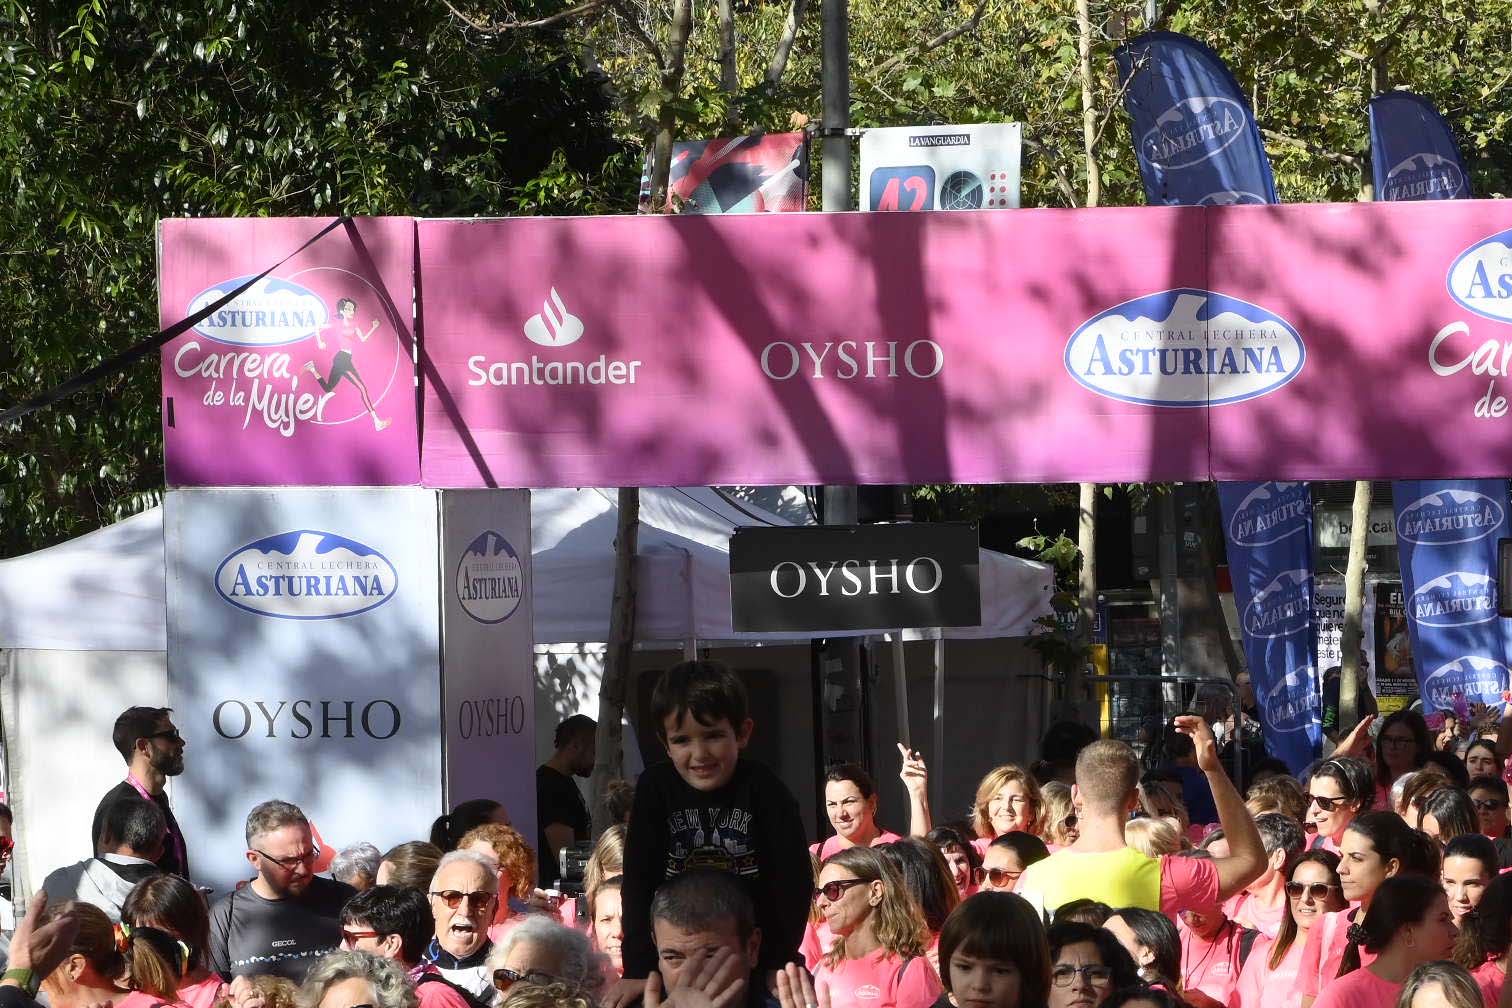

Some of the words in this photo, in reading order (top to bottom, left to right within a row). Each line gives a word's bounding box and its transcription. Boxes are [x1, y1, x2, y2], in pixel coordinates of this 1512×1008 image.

[199, 303, 318, 329] ASTURIANA
[1121, 330, 1194, 341] CENTRAL
[1204, 329, 1278, 340] LECHERA
[174, 341, 291, 379] Carrera
[468, 355, 642, 386] Santander
[761, 340, 945, 380] OYSHO
[1084, 334, 1286, 376] ASTURIANA
[203, 381, 224, 406] de
[230, 381, 246, 406] la
[243, 375, 337, 438] Mujer
[1474, 379, 1509, 419] de
[230, 564, 385, 597] ASTURIANA
[257, 561, 314, 570] CENTRAL
[321, 560, 379, 570] LECHERA
[462, 566, 519, 601] ASTURIANA
[770, 556, 943, 599] OYSHO
[212, 699, 401, 740] OYSHO
[459, 696, 525, 740] OYSHO
[708, 807, 752, 834] YORK
